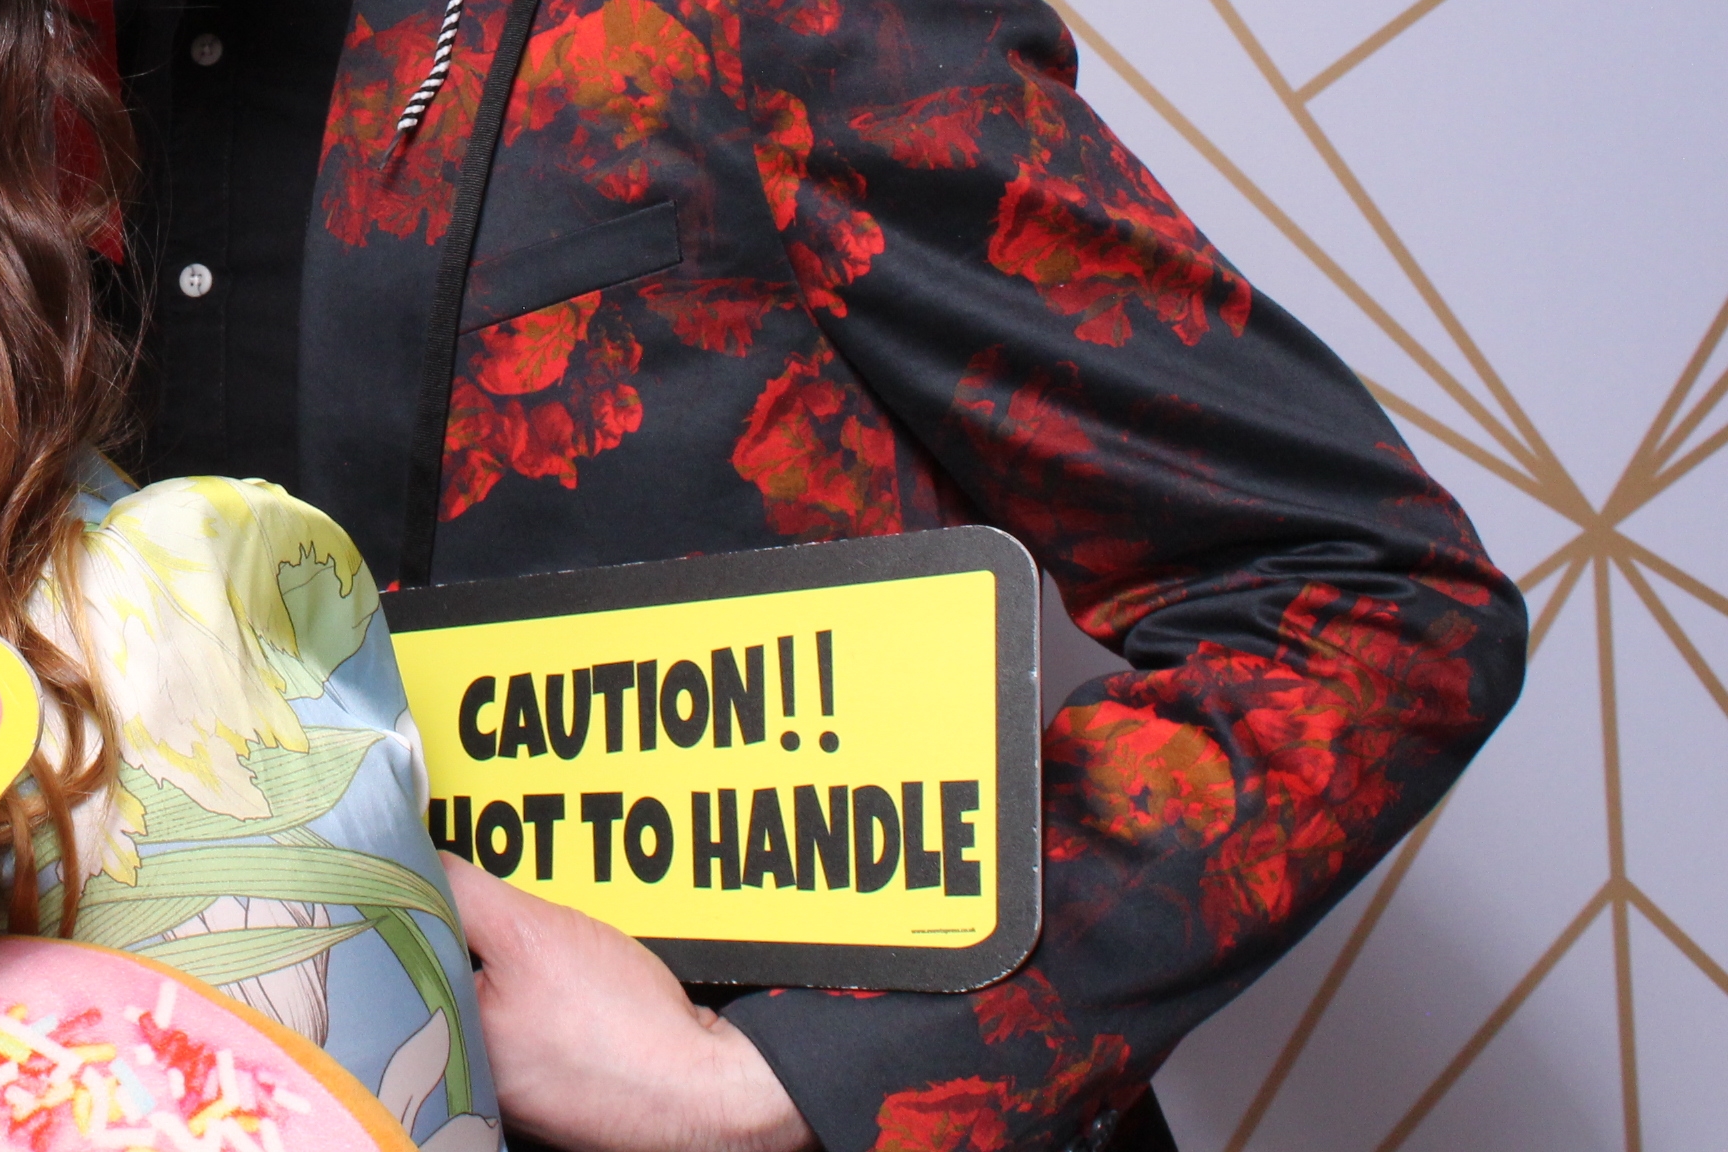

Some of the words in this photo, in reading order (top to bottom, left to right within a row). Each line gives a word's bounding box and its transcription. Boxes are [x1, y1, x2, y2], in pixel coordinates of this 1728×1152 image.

[458, 629, 840, 761] CAUTION!!
[428, 793, 565, 882] HOT
[580, 791, 675, 884] TO
[690, 779, 982, 897] HANDLE
